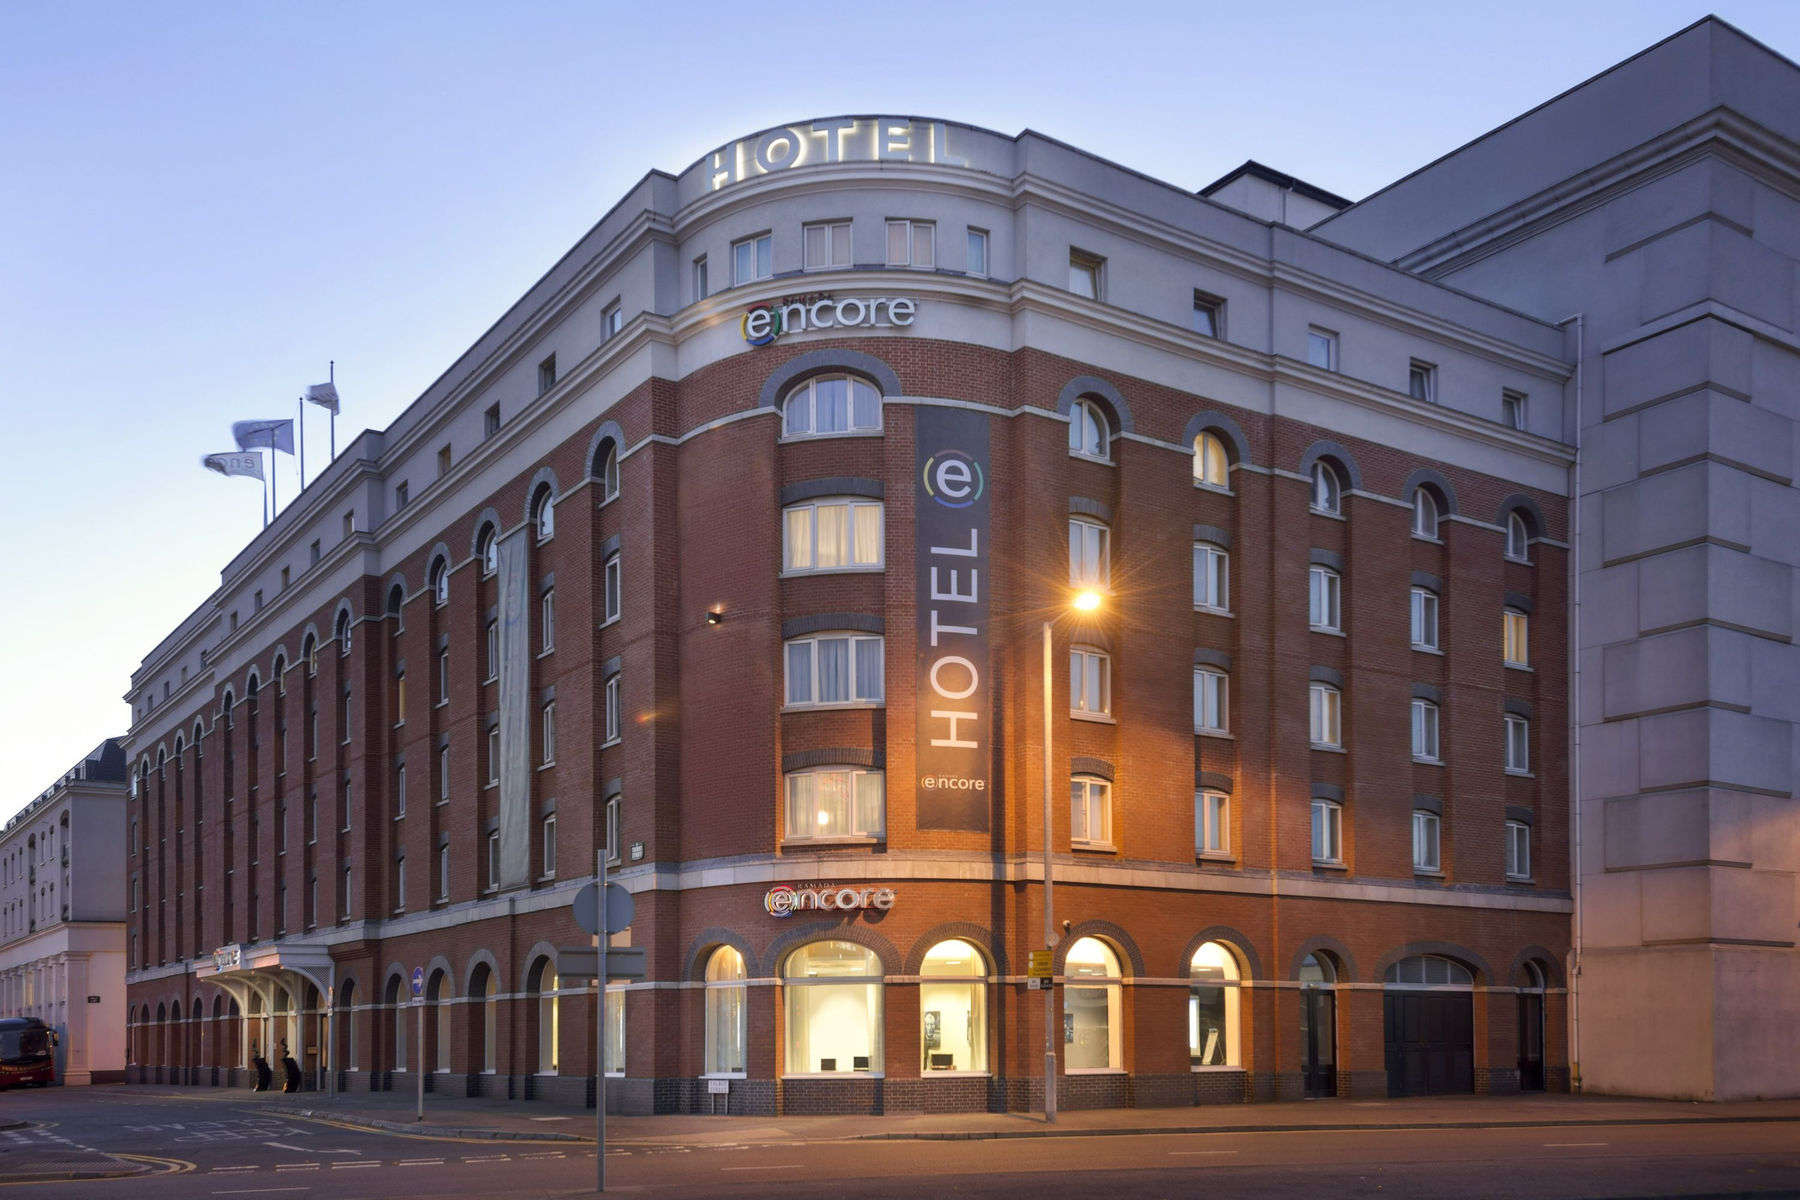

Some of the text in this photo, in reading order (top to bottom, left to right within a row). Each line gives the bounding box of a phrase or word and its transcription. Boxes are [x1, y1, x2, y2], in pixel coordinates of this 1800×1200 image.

[705, 117, 968, 191] HOTEL
[745, 298, 915, 338] encore
[930, 528, 978, 749] HOTEL
[924, 777, 985, 791] encore
[769, 887, 895, 912] encore
